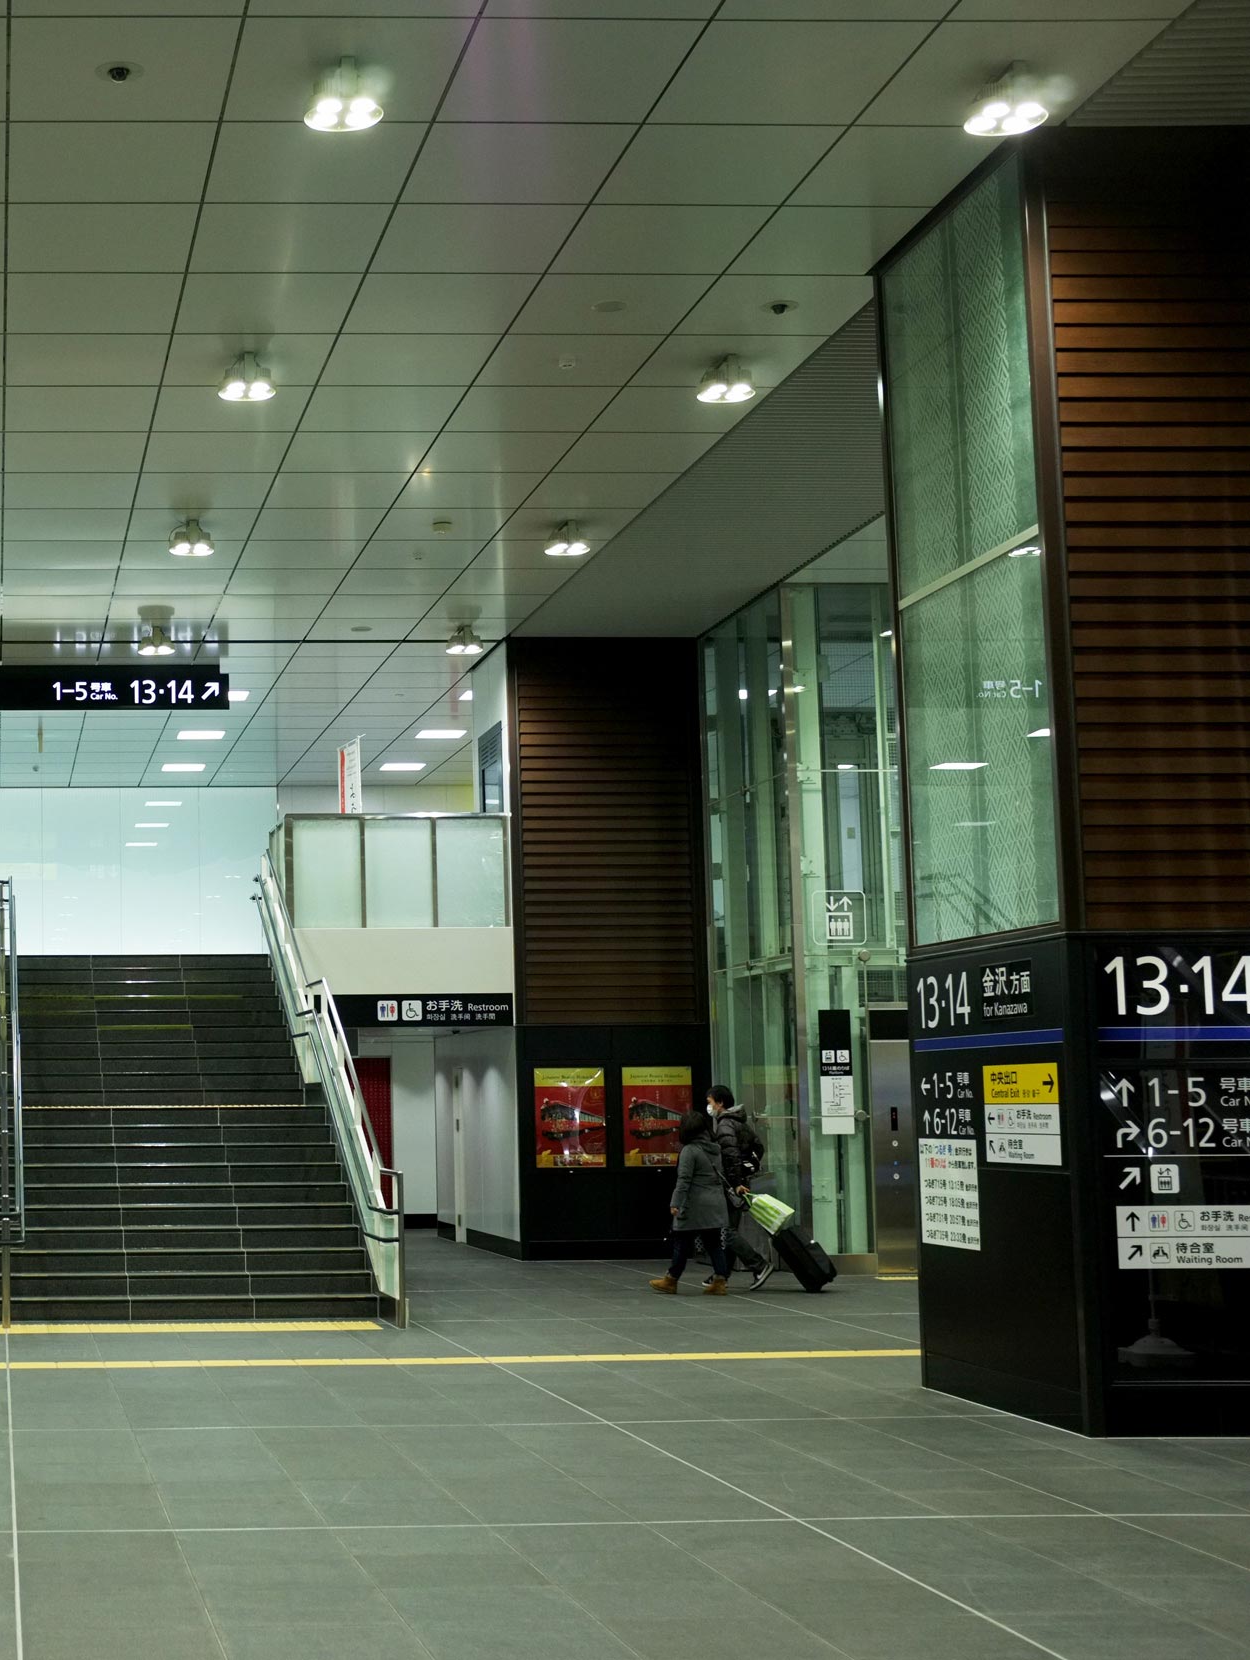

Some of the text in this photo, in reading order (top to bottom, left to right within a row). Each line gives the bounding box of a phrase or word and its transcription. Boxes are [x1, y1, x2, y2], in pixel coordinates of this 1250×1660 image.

[90, 692, 103, 700] Car
[426, 1000, 463, 1012] お手洗
[467, 1003, 509, 1012] Restroom
[983, 1002, 1028, 1017] for Kanazawa
[990, 1071, 1017, 1085] 中央出口
[1219, 1077, 1250, 1093] 号車
[991, 1088, 1020, 1098] Central Exit
[1220, 1096, 1241, 1107] Car
[1147, 1117, 1216, 1148] 6-12
[1222, 1137, 1243, 1147] Car
[1200, 1211, 1234, 1222] お手洗
[1175, 1242, 1214, 1254] 待合室
[1176, 1256, 1213, 1266] Waiting
